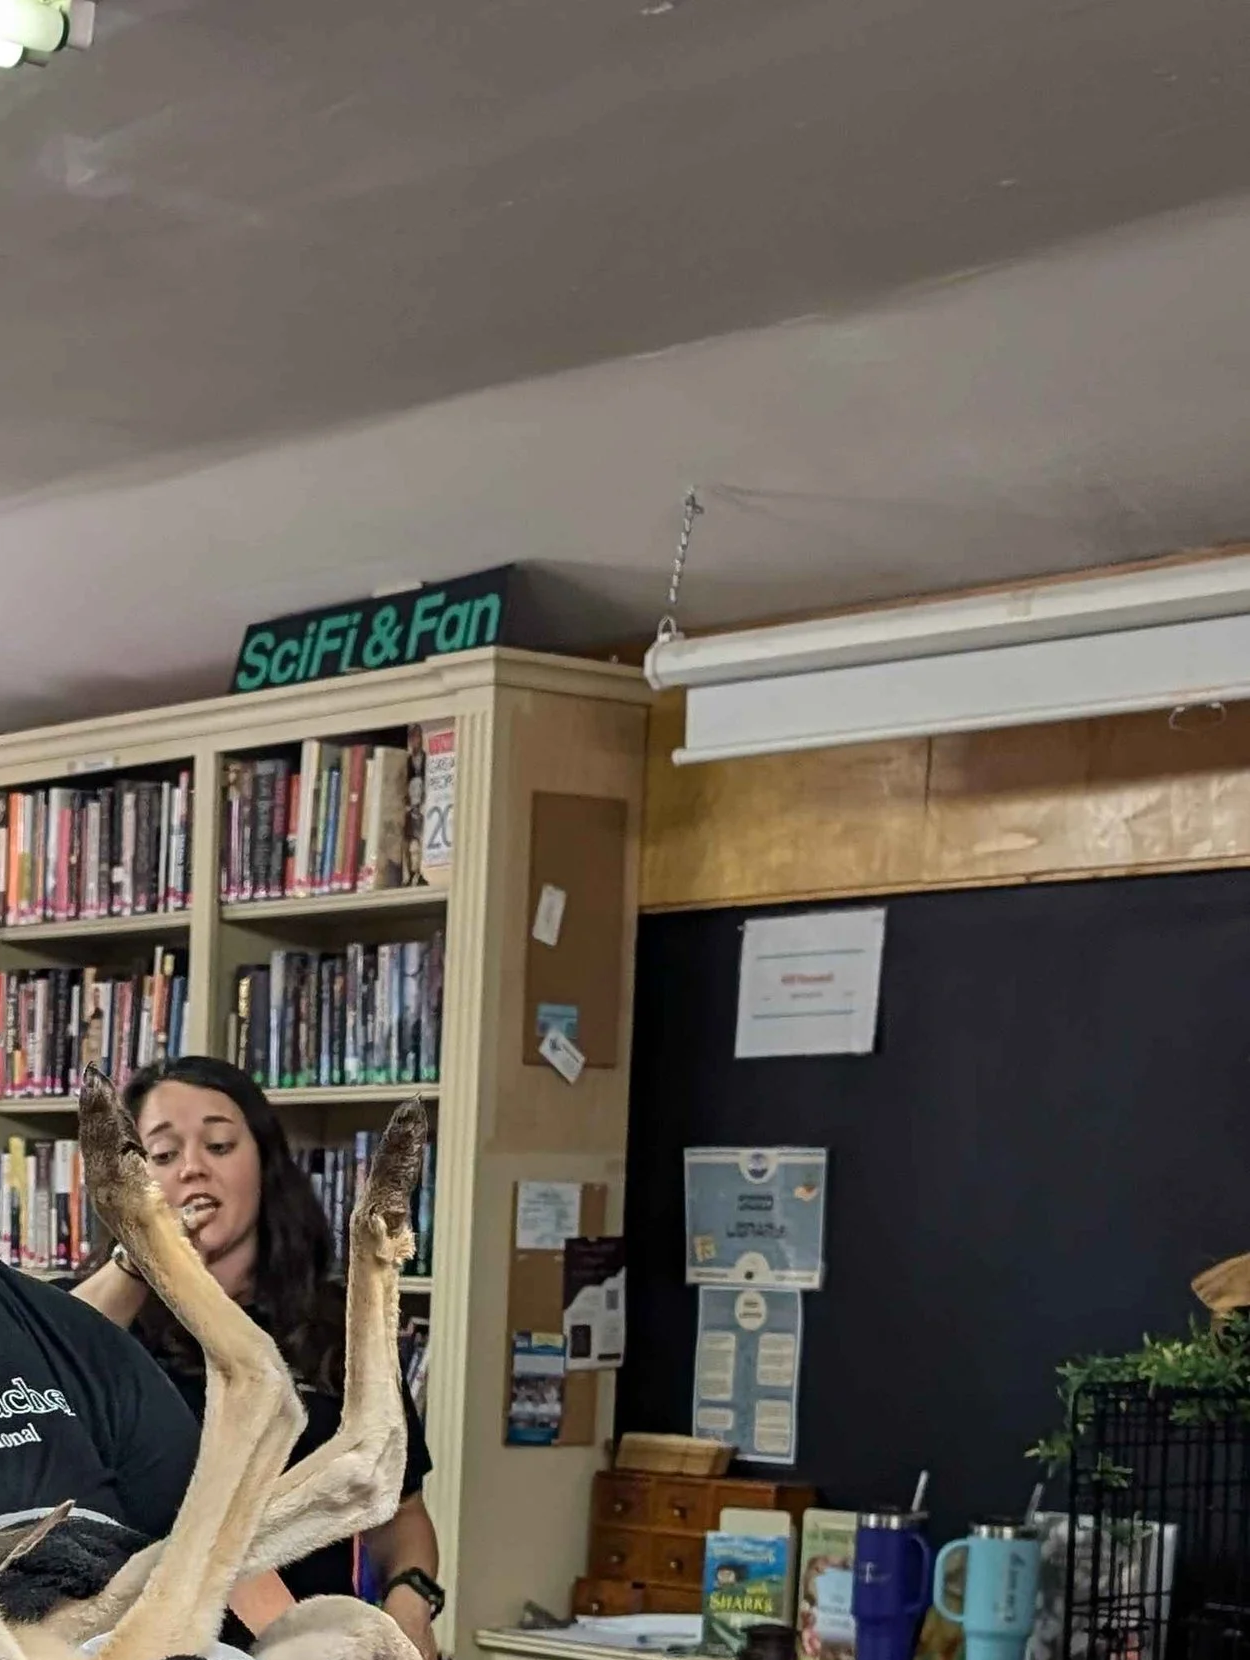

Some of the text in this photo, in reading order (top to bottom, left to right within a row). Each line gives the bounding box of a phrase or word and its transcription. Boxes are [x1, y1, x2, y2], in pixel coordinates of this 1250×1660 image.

[237, 591, 501, 691] SciFi & Fan
